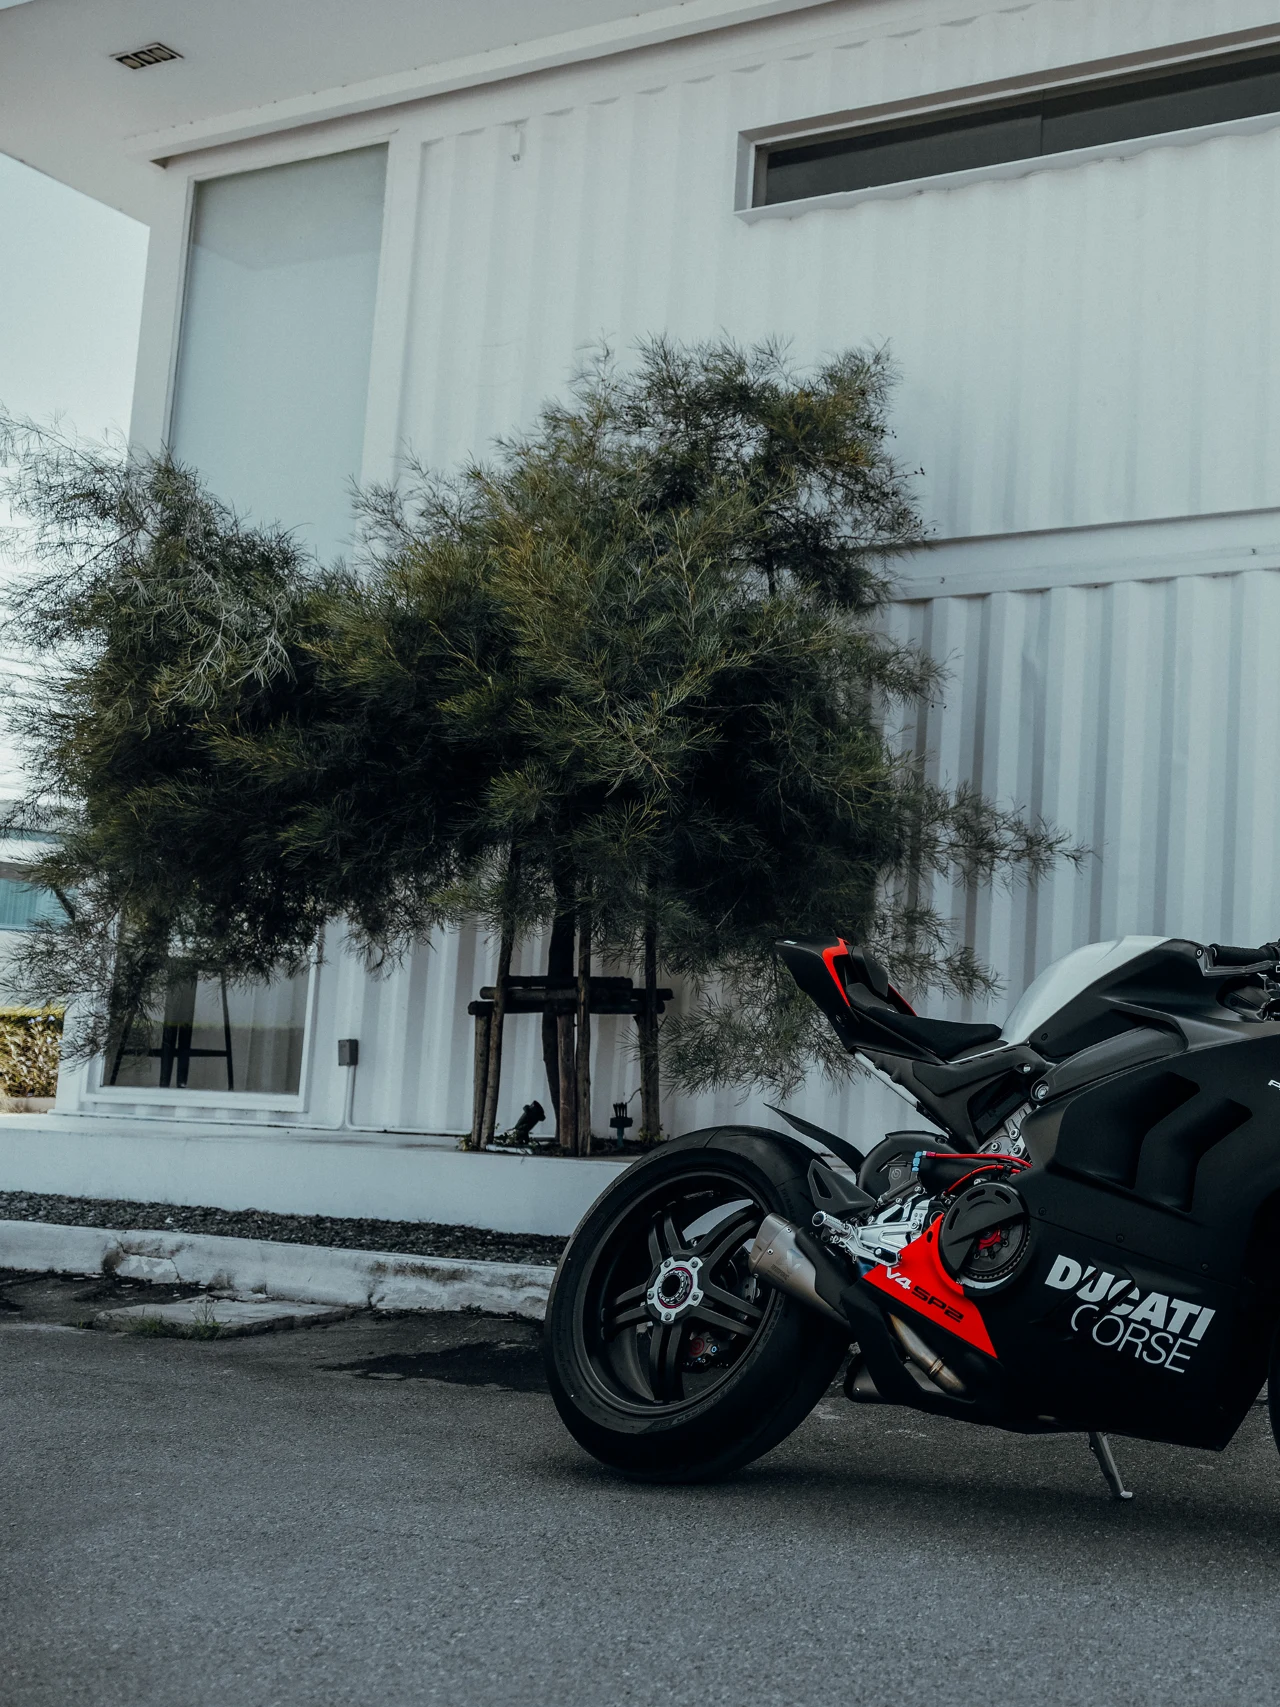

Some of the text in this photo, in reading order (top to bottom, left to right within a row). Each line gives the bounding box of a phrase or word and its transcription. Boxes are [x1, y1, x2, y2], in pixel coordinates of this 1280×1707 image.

[886, 1266, 965, 1324] V4 SP2
[1044, 1254, 1216, 1341] DUCATI
[1070, 1304, 1199, 1374] CORSE
